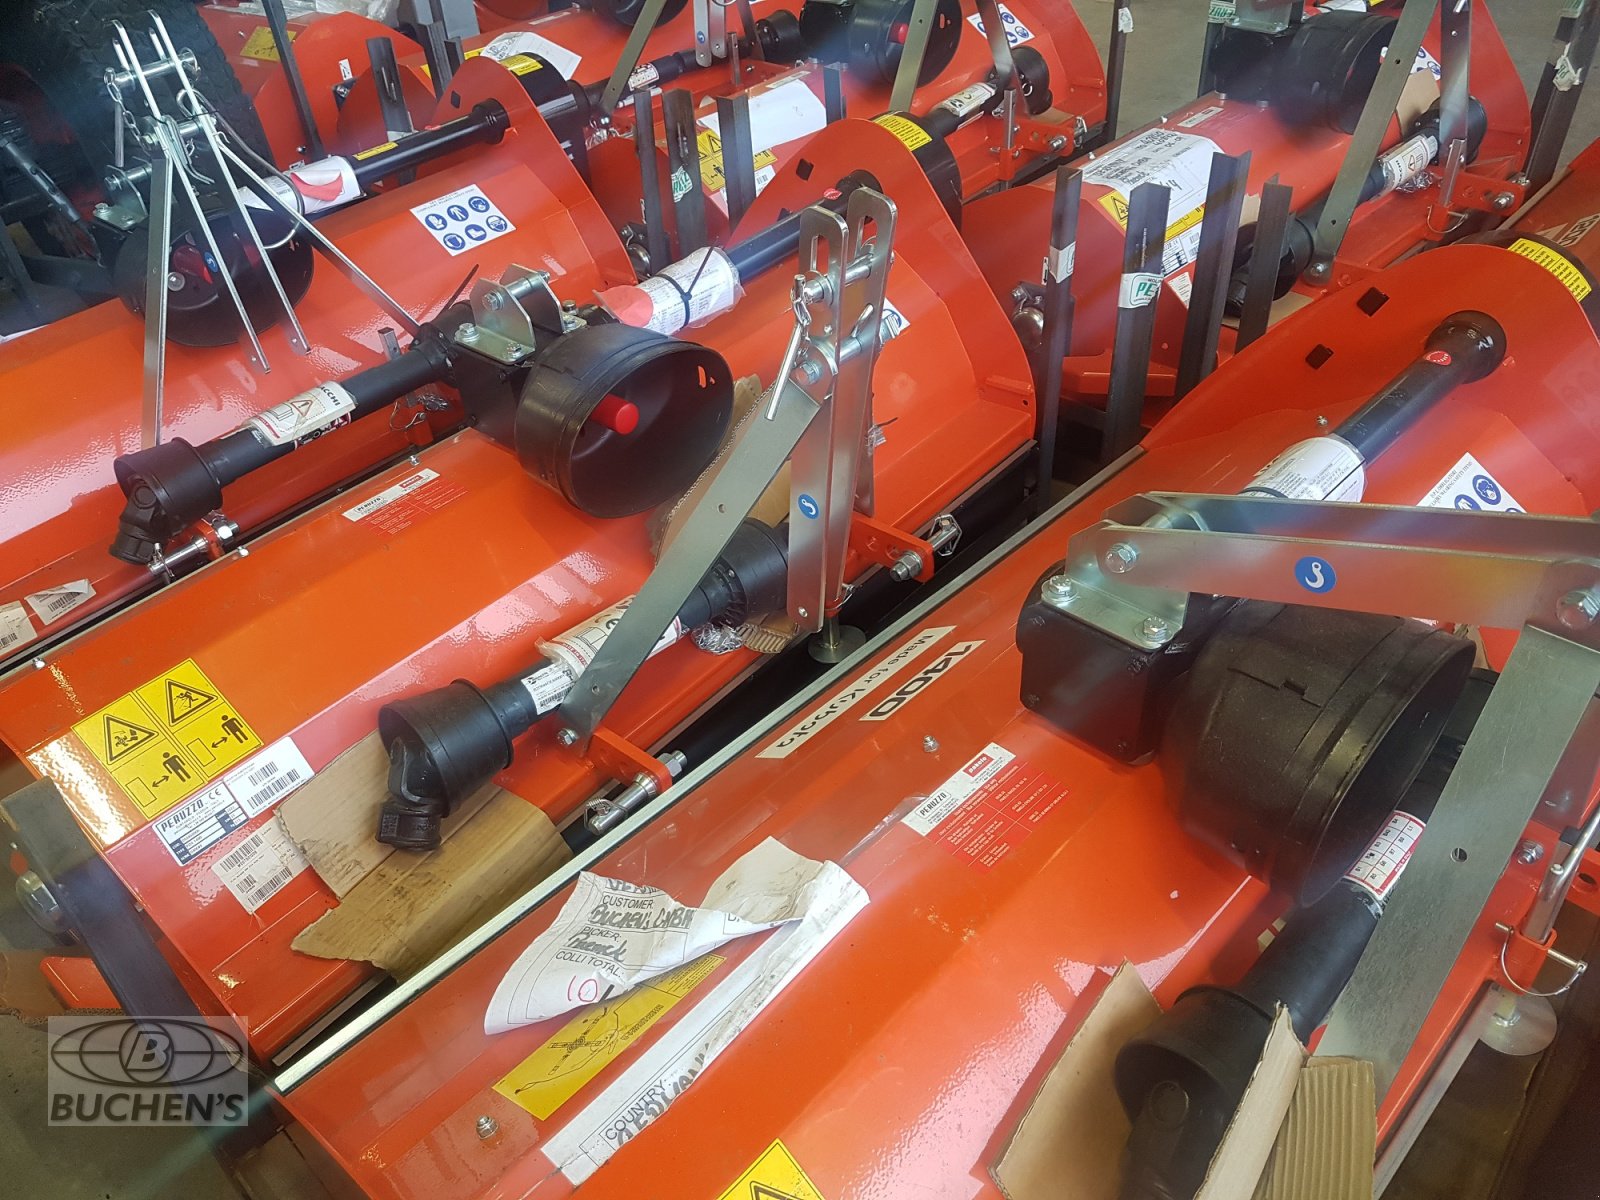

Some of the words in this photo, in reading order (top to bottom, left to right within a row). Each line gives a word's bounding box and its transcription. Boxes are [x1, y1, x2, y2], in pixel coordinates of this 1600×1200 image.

[888, 635, 933, 665] Made
[864, 668, 888, 683] for
[869, 644, 972, 717] 1400
[776, 688, 865, 747] Kubota
[160, 799, 204, 831] PERUZZO
[919, 791, 947, 816] PERUZZO
[603, 895, 654, 909] CUSTOMER:
[582, 926, 622, 942] PICKER:
[556, 950, 587, 963] COLLI
[587, 952, 625, 978] TOTAL:
[603, 1079, 669, 1142] COUNTRY:
